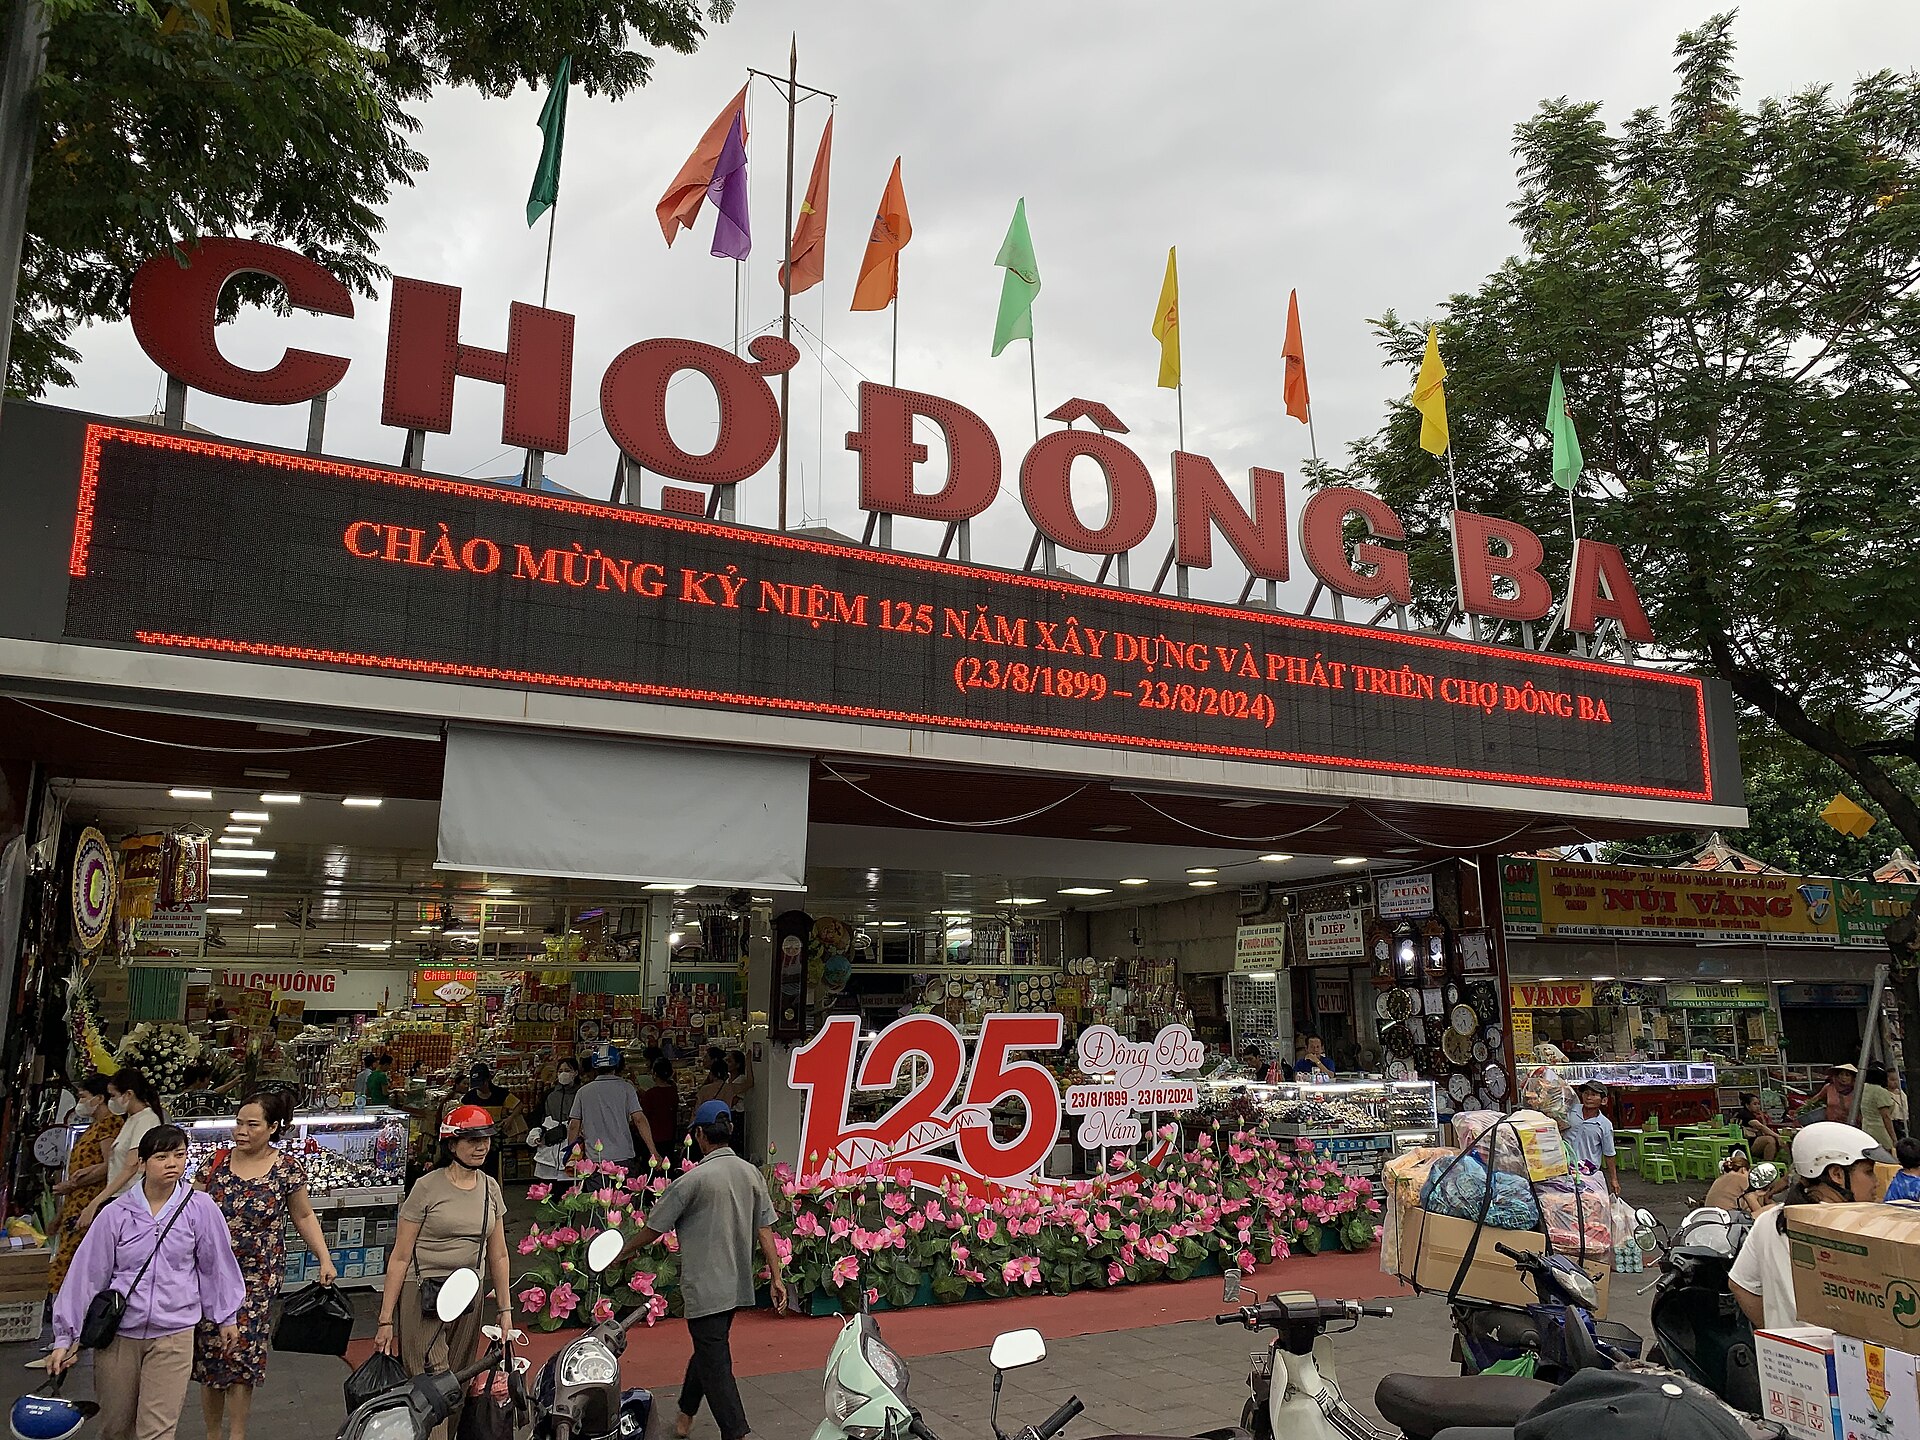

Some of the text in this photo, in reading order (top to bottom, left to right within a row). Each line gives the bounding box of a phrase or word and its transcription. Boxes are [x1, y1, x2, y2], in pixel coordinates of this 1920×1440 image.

[130, 236, 1653, 643] CHỢ ĐÔNG BA
[344, 521, 1612, 723] CHÀO MỪNG KỶ NIỆM 125 NĂM XÂY DỰNG VÀ PHÁT TRIỂN CHỢ ĐÔNG BA
[954, 656, 1107, 701] (23/8/1899
[1139, 679, 1275, 728] 23/8/2024)
[1602, 884, 1677, 913] NÚI
[1686, 889, 1794, 918] VÀNG
[1321, 922, 1346, 936] DIỆP
[424, 969, 451, 981] Thiên
[790, 1017, 1200, 1194] 125 Đông Ba
[1071, 1090, 1128, 1109] 23/8/1899
[1138, 1088, 1194, 1105] 23/8/2024
[1083, 1109, 1137, 1143] Năm
[1823, 1281, 1886, 1309] SUWADEE
